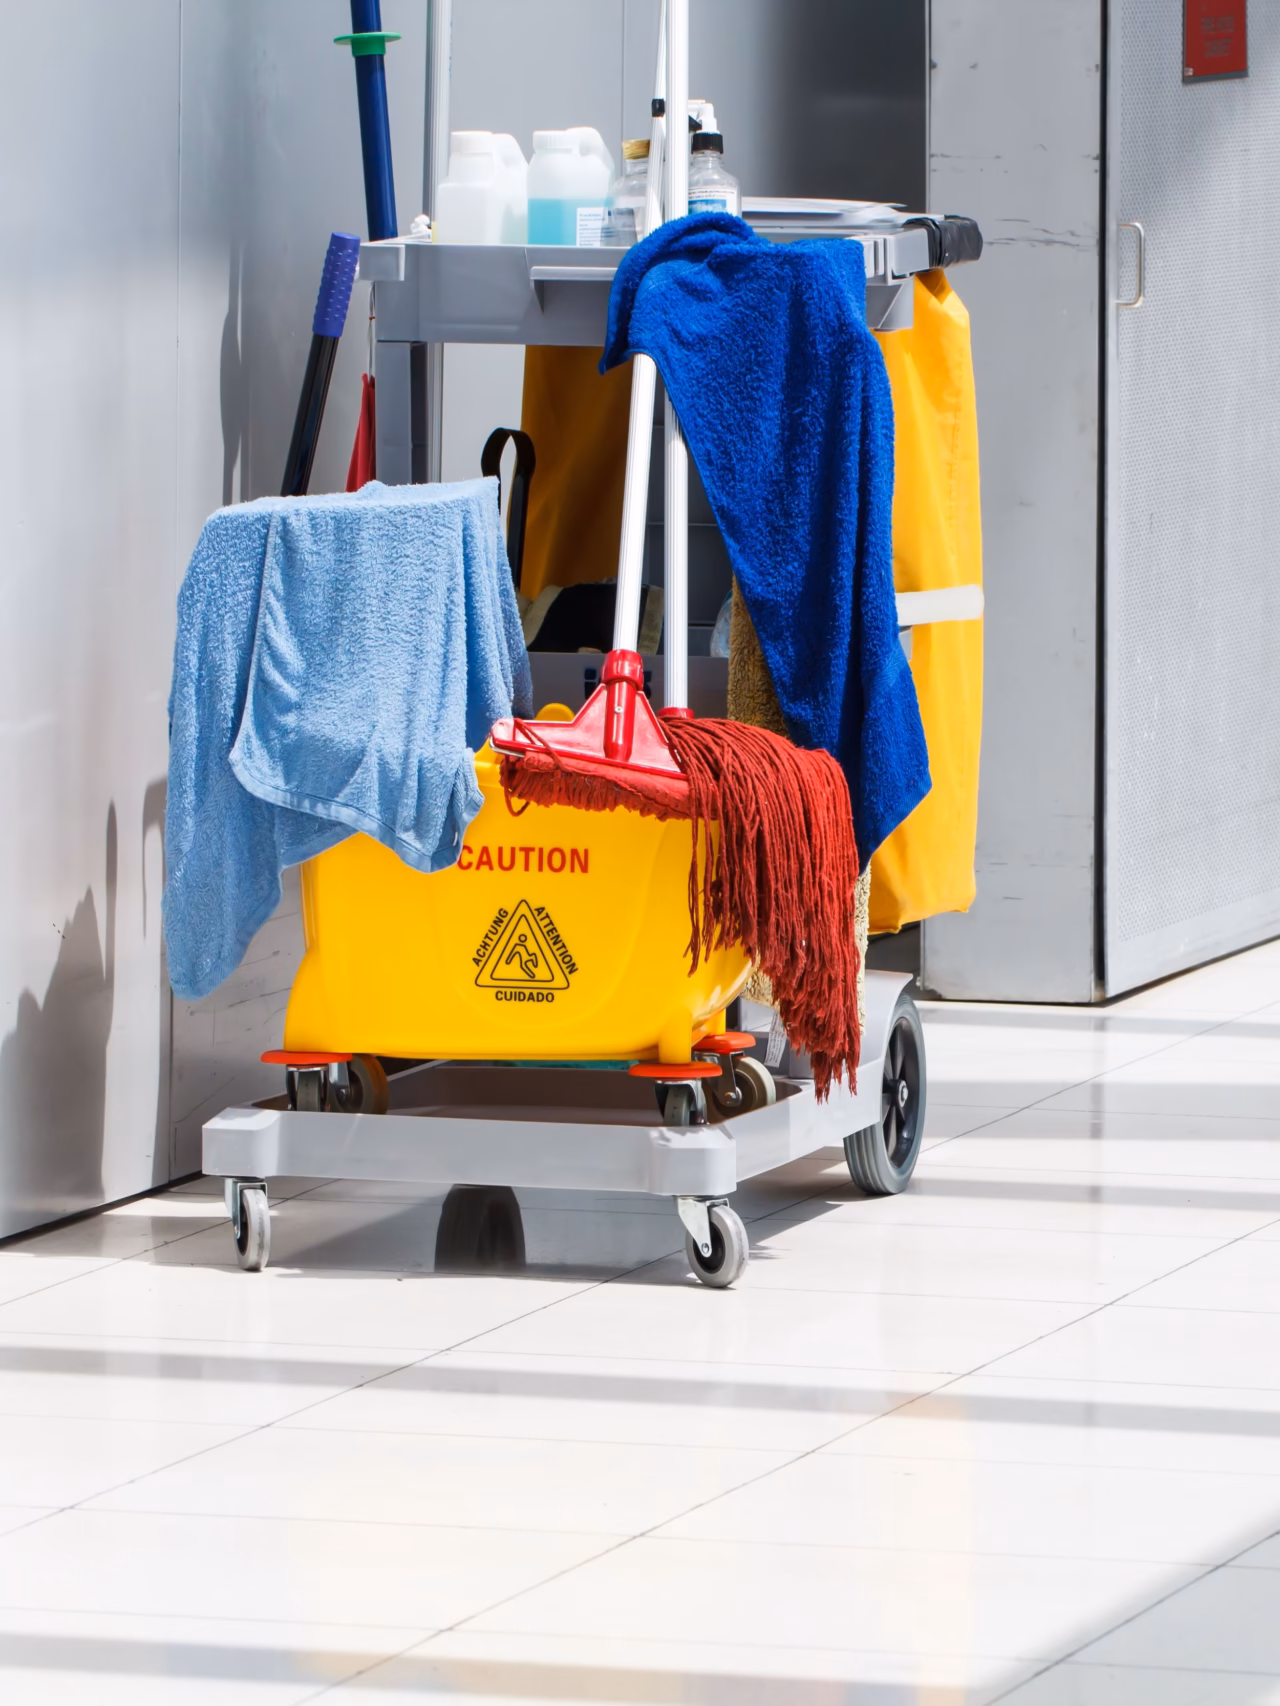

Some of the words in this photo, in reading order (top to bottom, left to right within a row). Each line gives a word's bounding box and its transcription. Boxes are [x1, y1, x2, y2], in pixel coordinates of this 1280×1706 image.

[457, 845, 589, 874] CAUTION
[472, 907, 509, 967] ACHTUNG
[534, 906, 579, 975] ATTENTION
[495, 990, 555, 1003] CUIDADO
